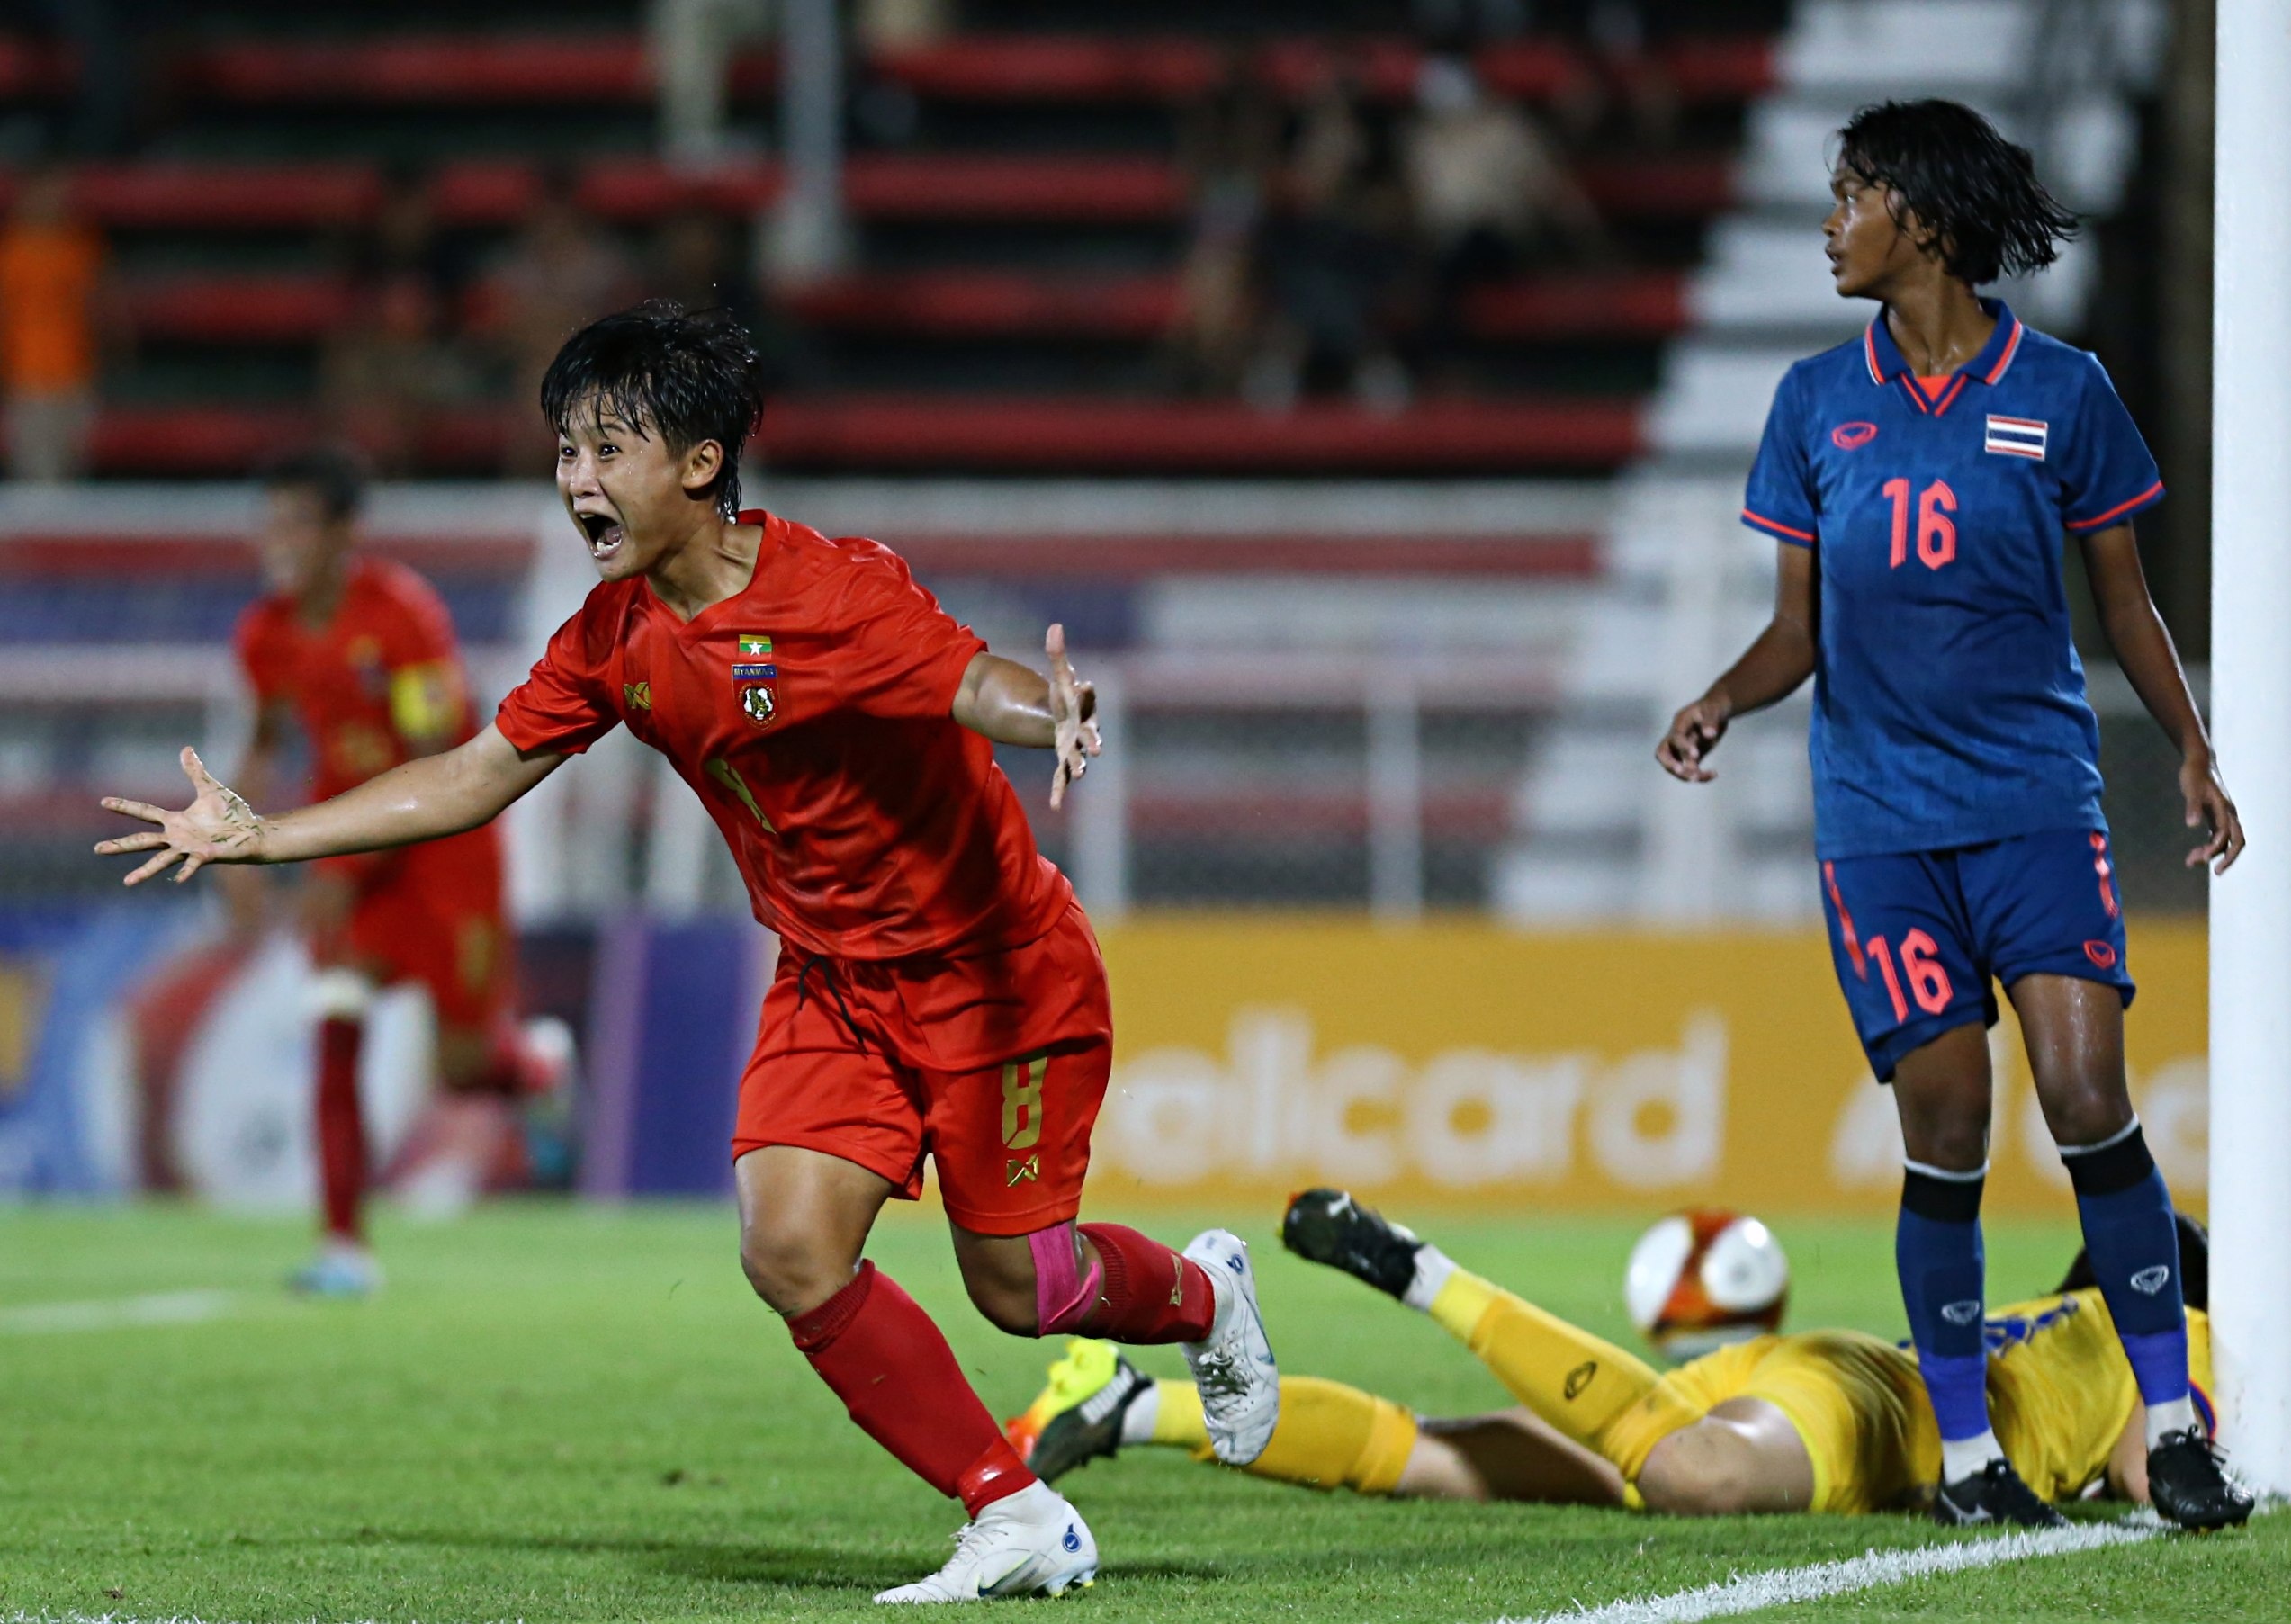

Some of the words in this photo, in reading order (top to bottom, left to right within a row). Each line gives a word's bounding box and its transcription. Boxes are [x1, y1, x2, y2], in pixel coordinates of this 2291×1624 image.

[1882, 478, 1957, 570] 16
[1866, 927, 1954, 1025] 16
[1002, 1049, 1047, 1150] 8
